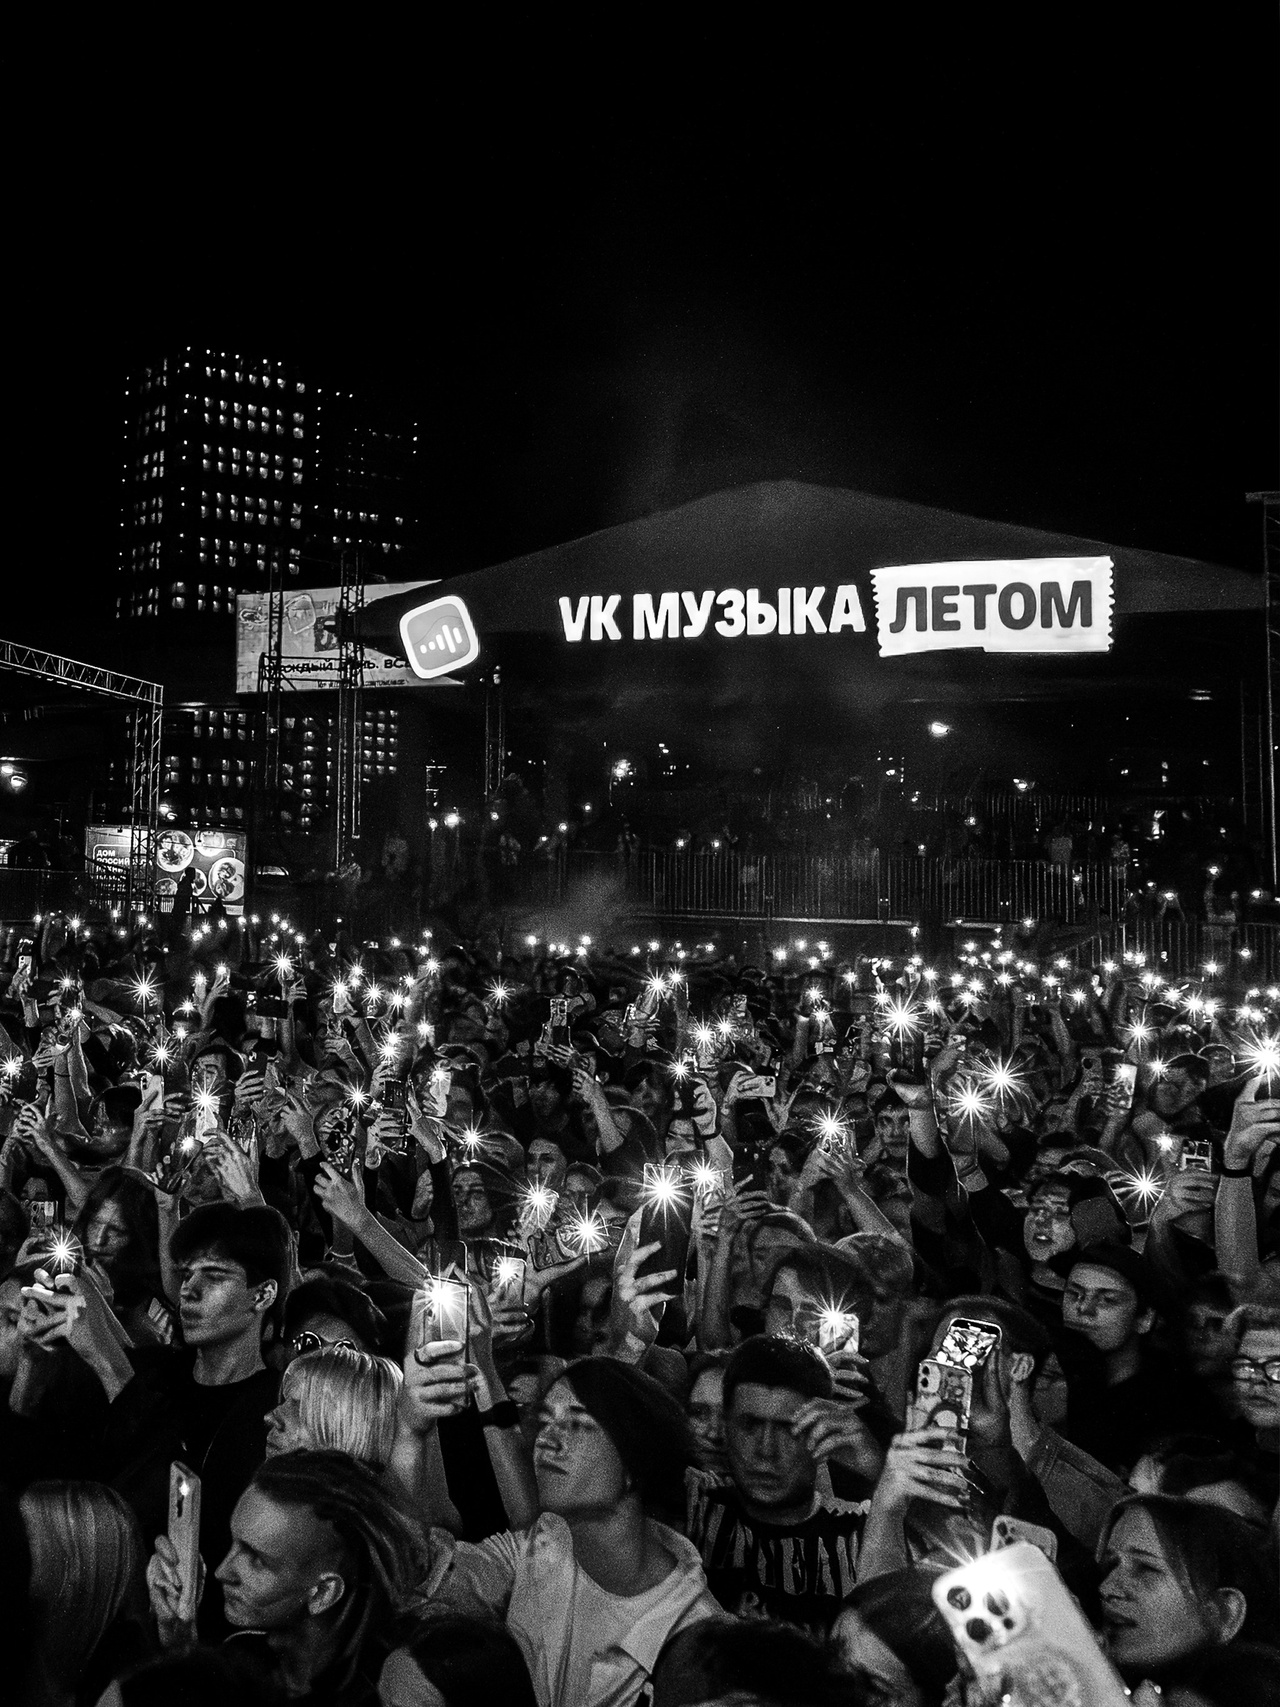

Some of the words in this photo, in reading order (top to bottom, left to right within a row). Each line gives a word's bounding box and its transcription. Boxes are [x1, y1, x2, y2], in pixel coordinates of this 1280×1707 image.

[558, 594, 622, 642] VK
[632, 584, 867, 640] МУЗЫКА
[889, 580, 1093, 634] ЛЕТОМ
[96, 849, 116, 858] ДОМ
